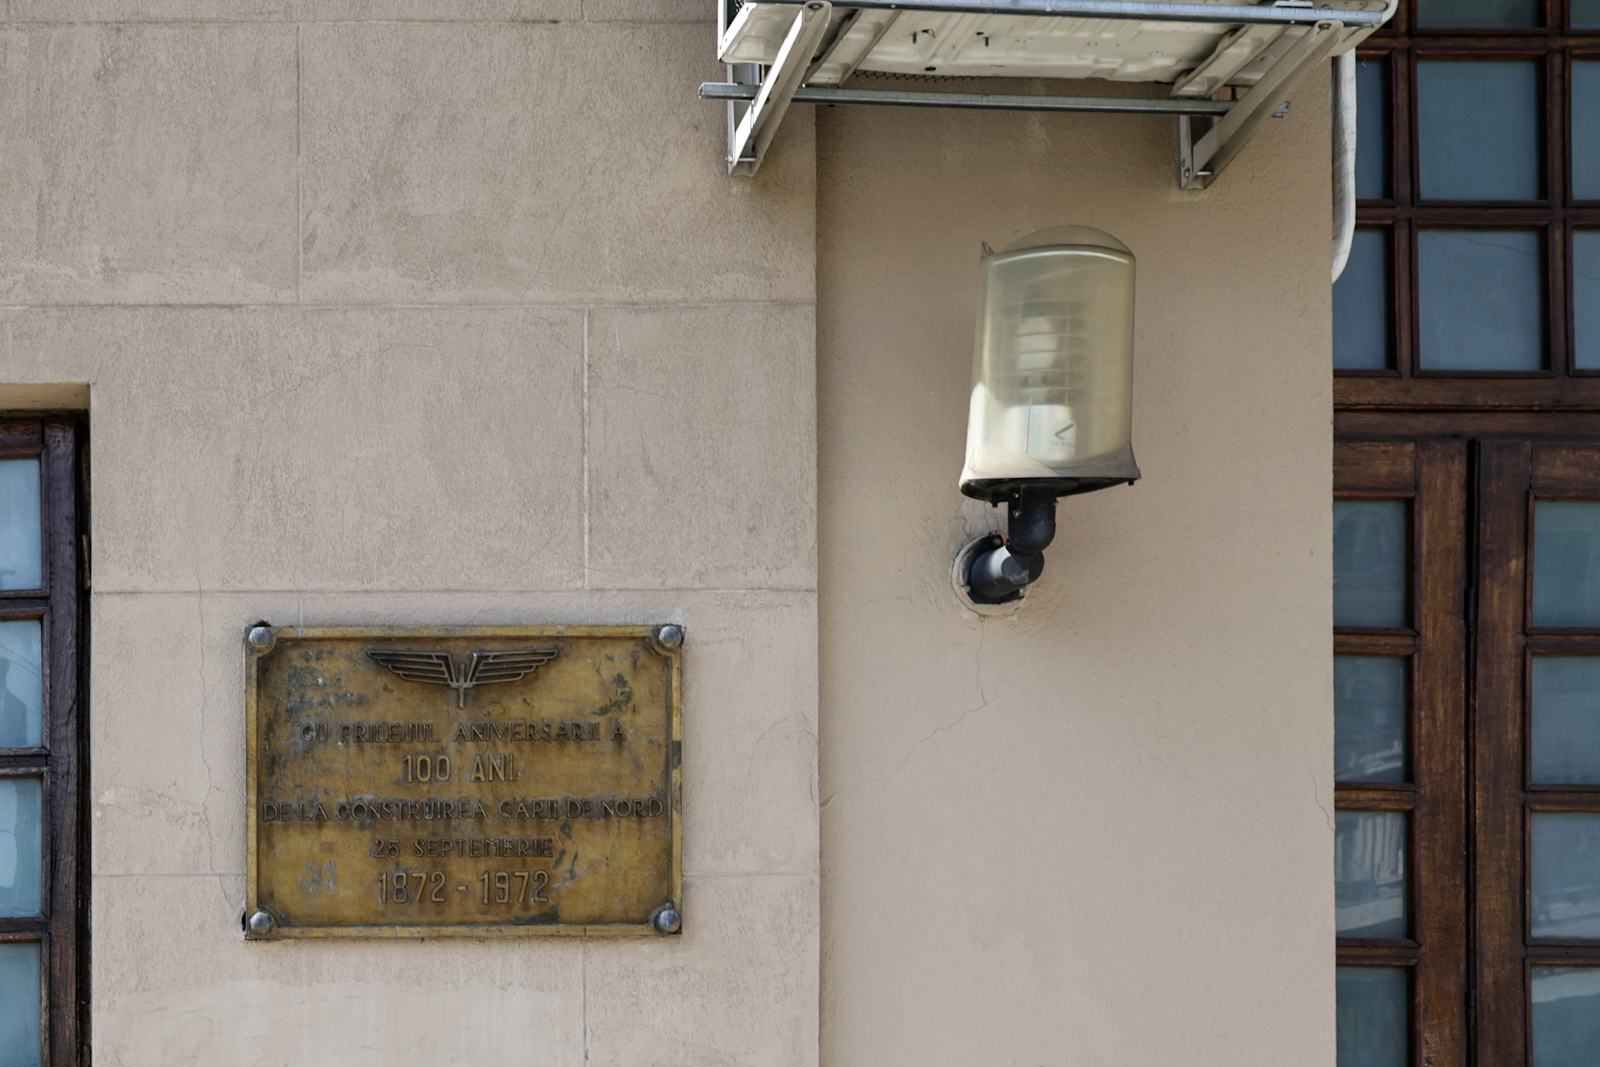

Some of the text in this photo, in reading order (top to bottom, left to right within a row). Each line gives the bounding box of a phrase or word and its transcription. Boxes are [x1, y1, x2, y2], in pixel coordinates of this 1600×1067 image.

[300, 721, 628, 743] CU PRILEJUL ANIVERSARII A
[402, 753, 515, 783] 100 ANI
[263, 799, 664, 822] DE LA CONSTRUIREA GARII DE NORD
[373, 837, 554, 859] 25 SEPTEMBRIE
[377, 871, 447, 904] 1872
[479, 869, 550, 905] 1972
